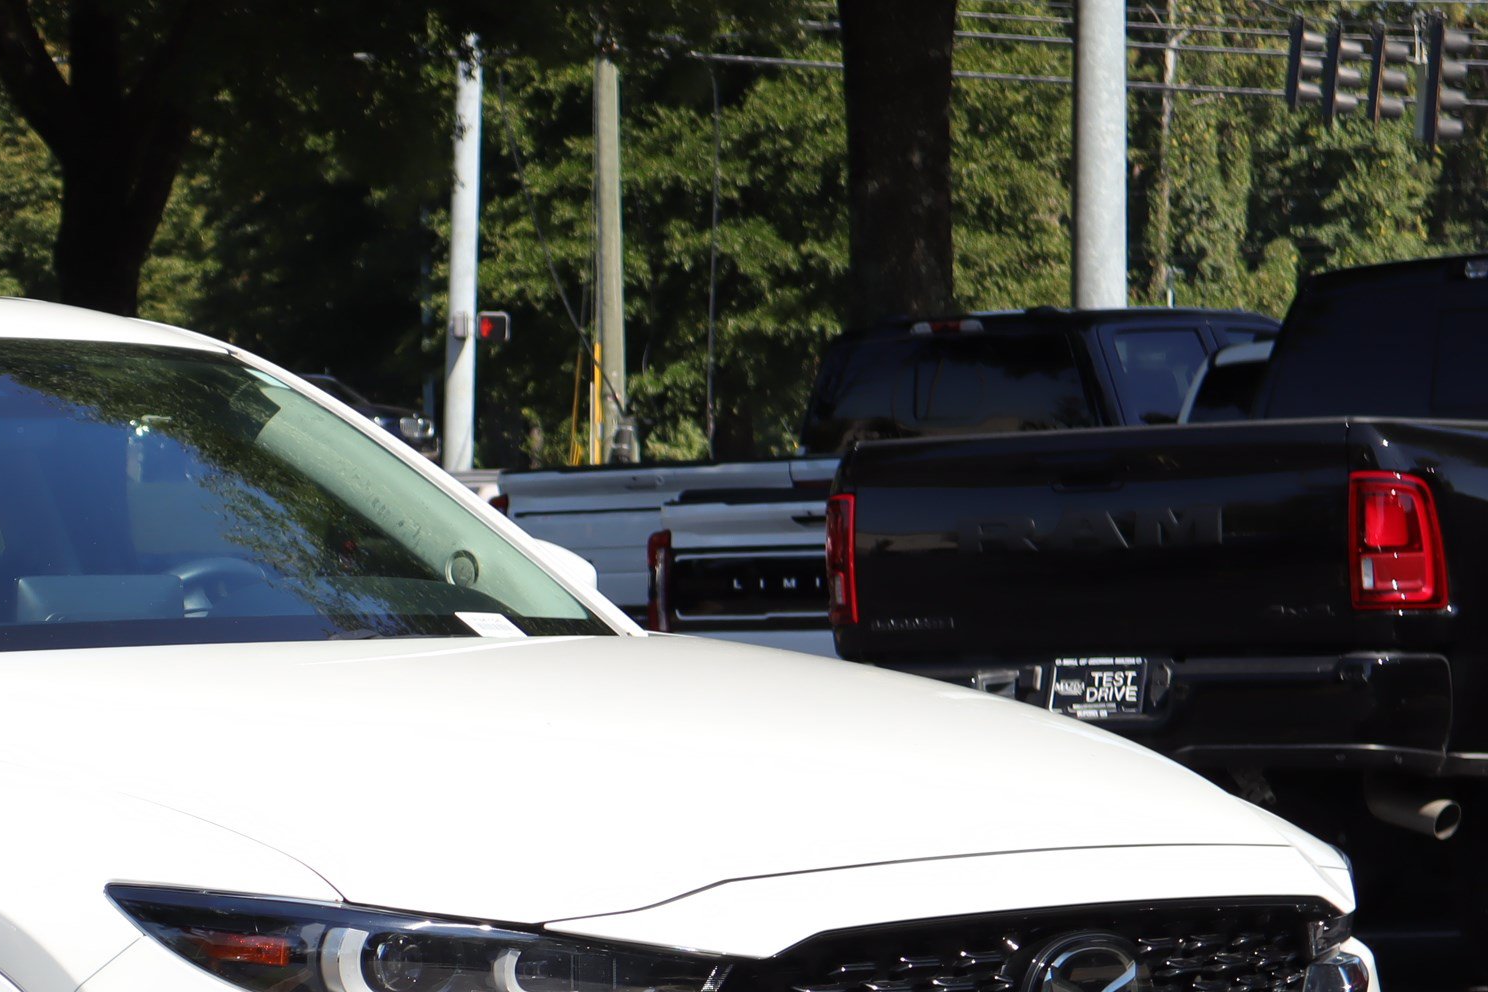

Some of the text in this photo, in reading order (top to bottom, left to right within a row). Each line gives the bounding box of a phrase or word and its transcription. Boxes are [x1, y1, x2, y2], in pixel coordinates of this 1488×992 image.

[975, 505, 1222, 553] RAM
[1091, 671, 1136, 687] TEST
[1086, 686, 1138, 702] DRIVE
